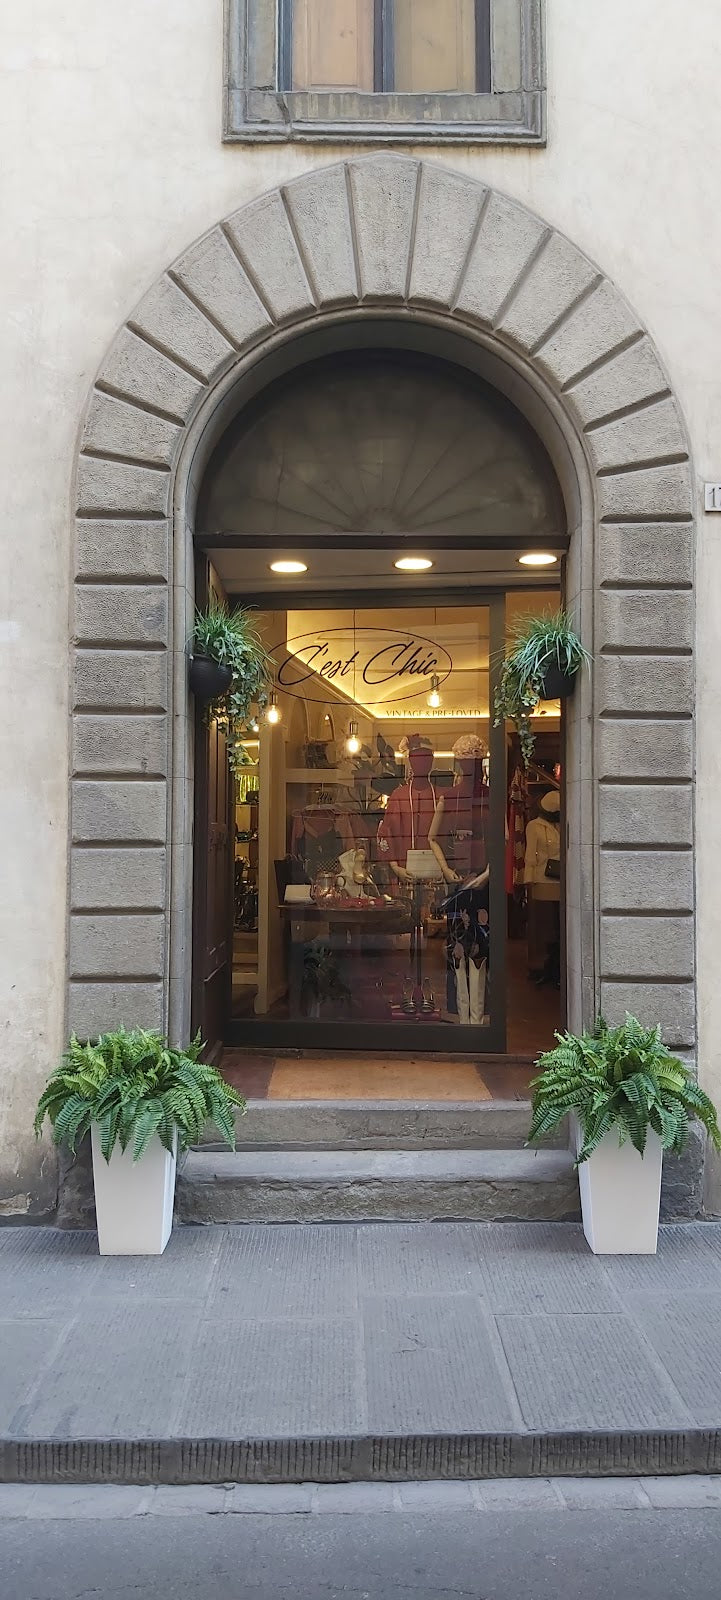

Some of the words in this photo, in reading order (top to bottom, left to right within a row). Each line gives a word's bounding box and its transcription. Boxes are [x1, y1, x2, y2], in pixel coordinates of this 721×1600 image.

[278, 642, 359, 686] C'est
[363, 641, 438, 685] Chic
[385, 709, 423, 717] VINTAGE
[432, 709, 481, 717] PRE-LOVED
